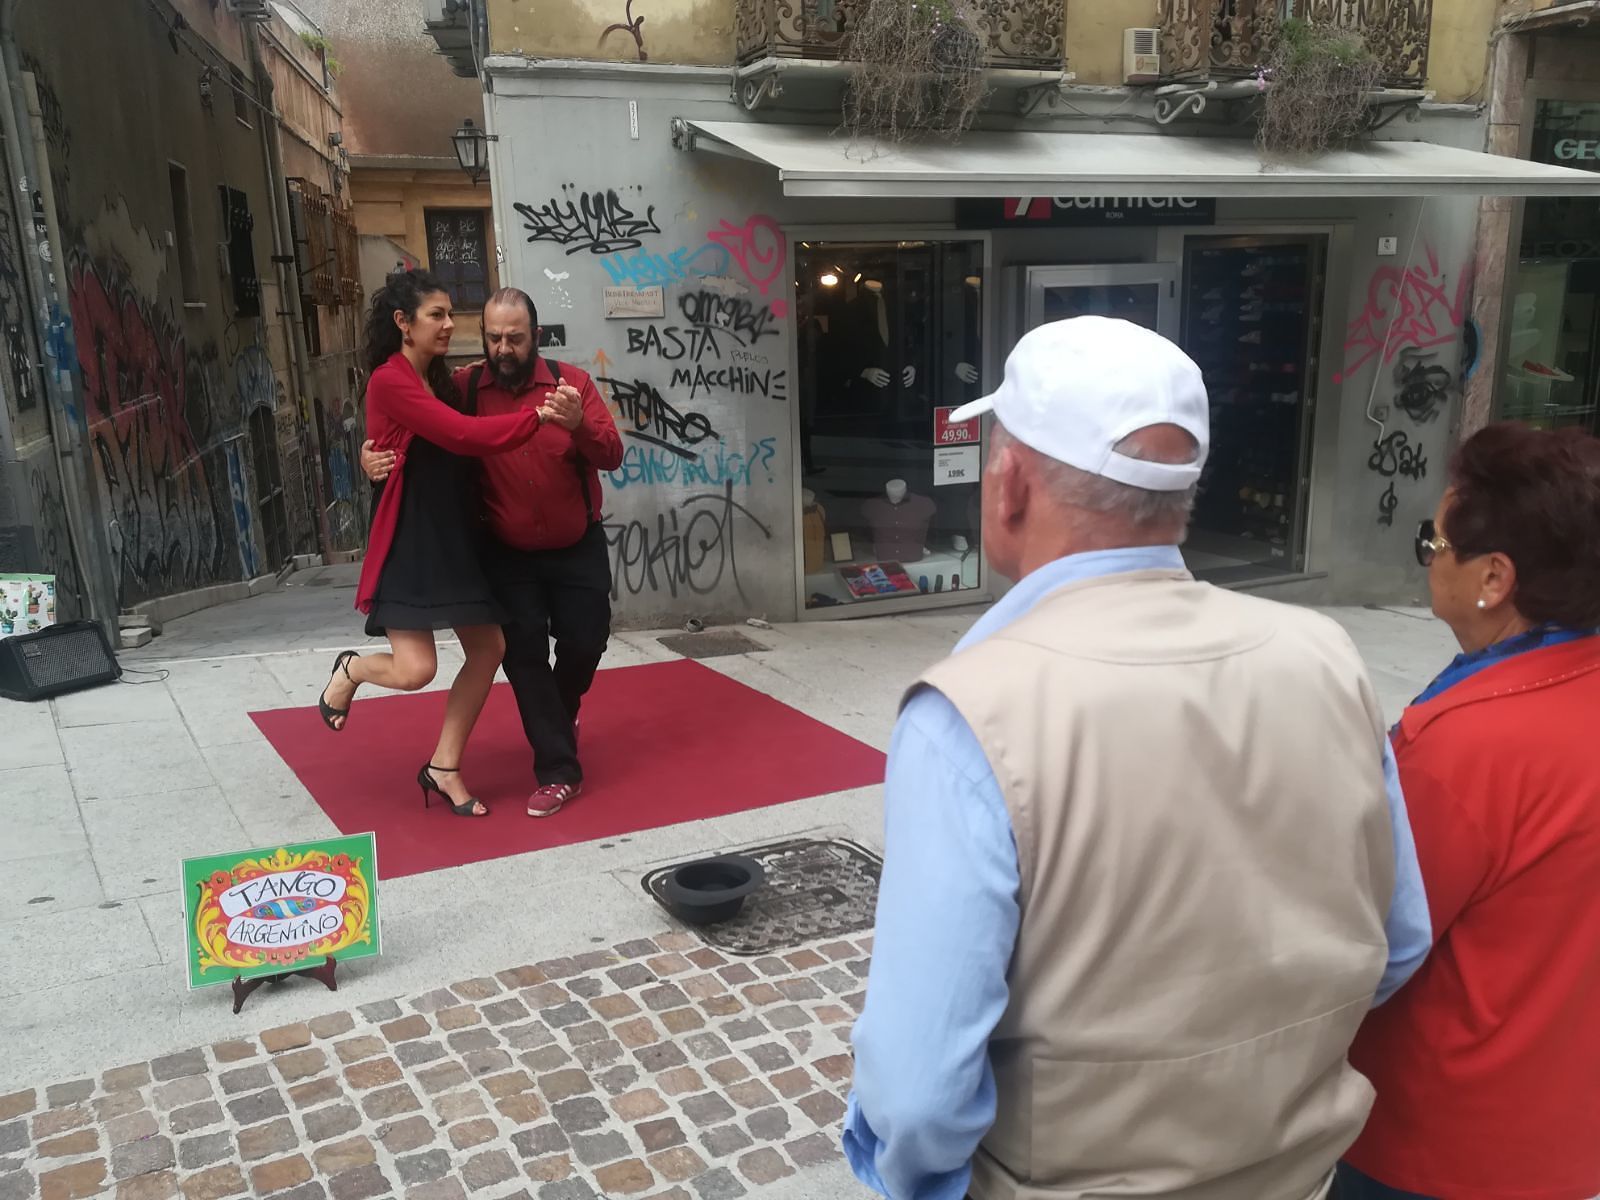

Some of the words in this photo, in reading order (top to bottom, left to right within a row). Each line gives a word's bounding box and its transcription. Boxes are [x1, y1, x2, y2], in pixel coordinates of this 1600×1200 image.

[1554, 138, 1600, 160] GE
[627, 325, 721, 363] BASTA
[229, 871, 336, 908] TANGO
[230, 914, 338, 945] ARGENTINO
